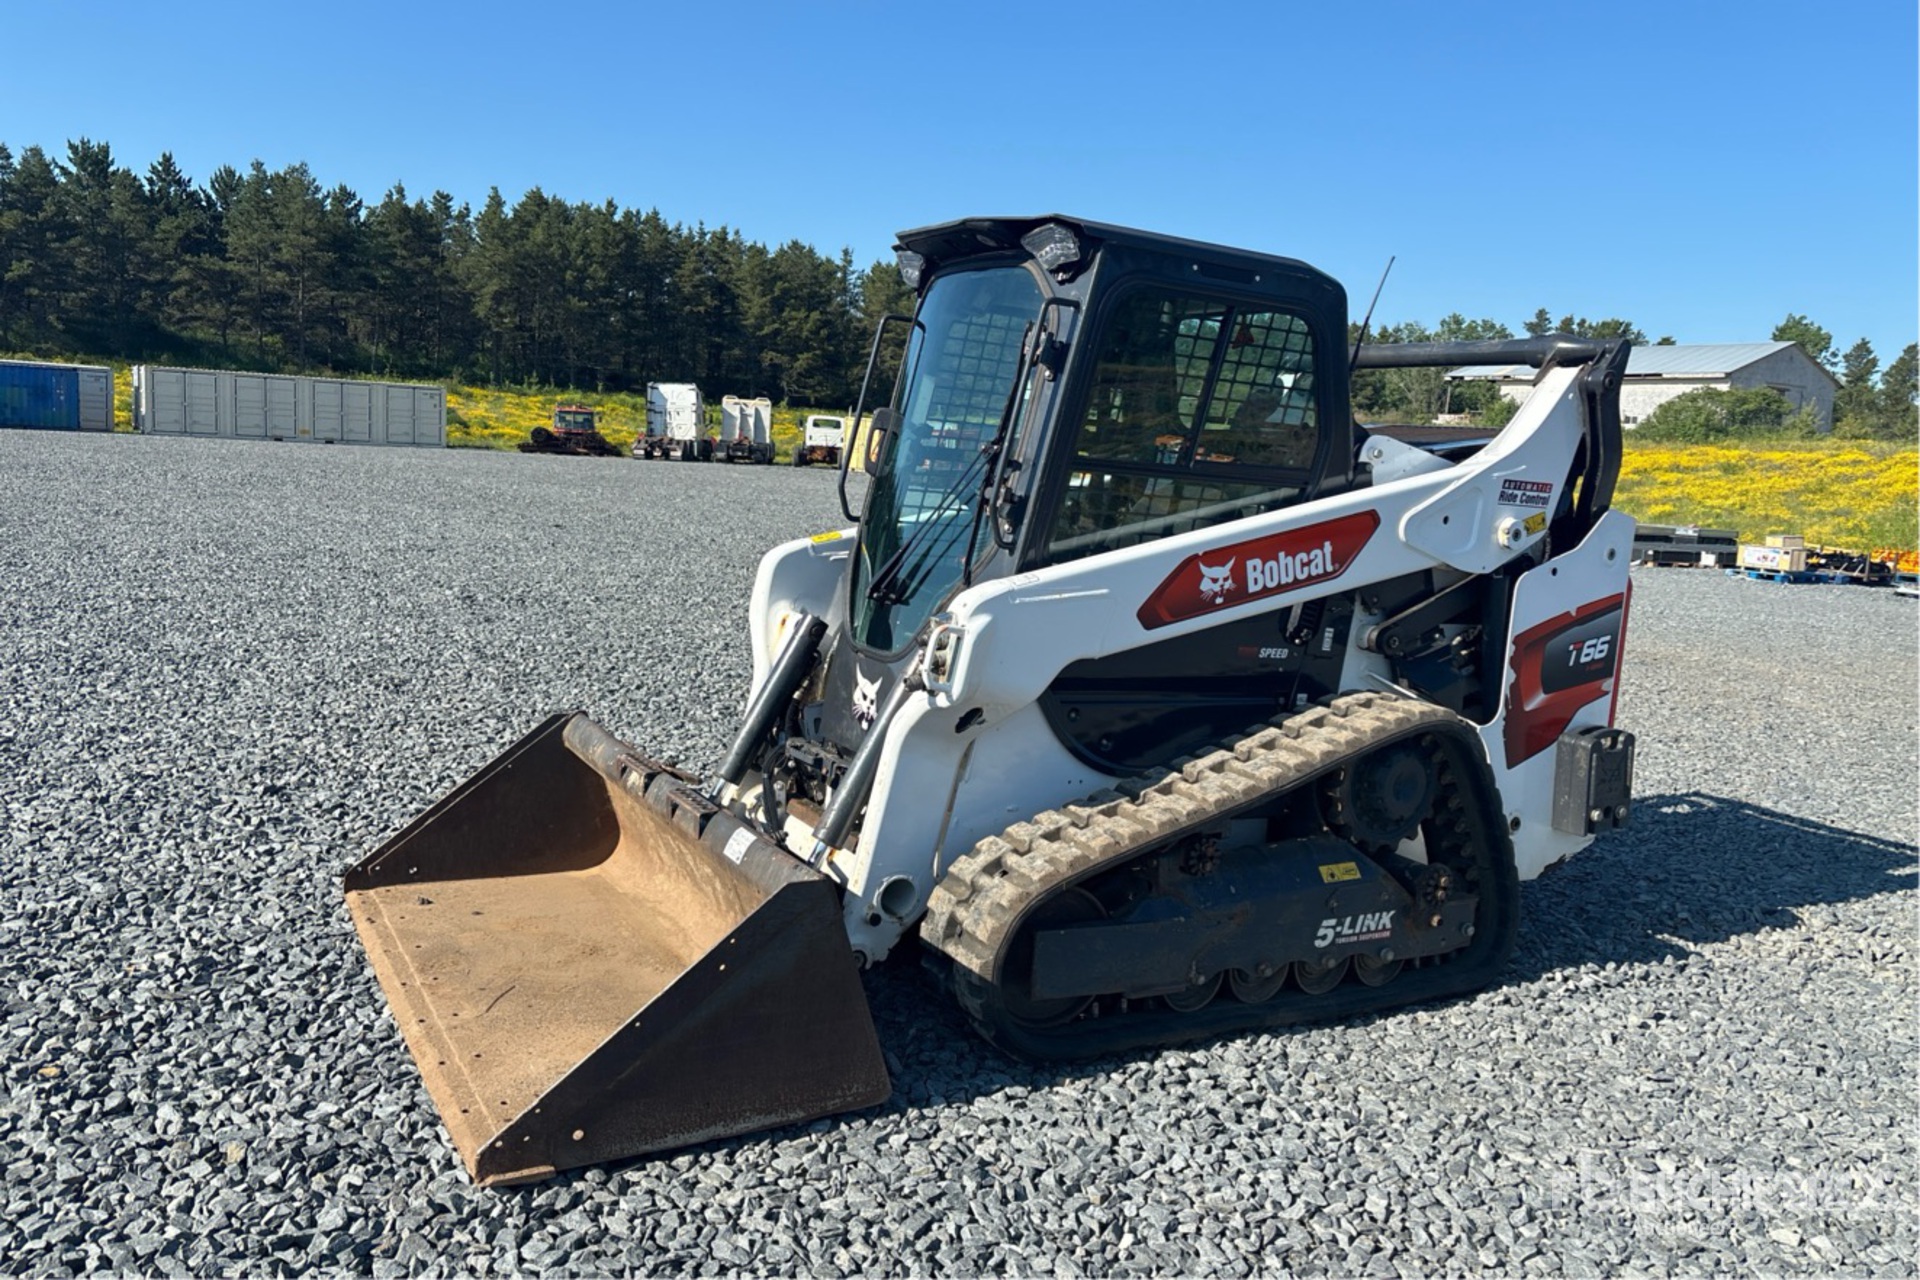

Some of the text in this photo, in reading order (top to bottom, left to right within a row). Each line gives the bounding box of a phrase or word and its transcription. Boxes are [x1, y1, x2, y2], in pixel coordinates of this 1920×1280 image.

[1499, 490, 1550, 506] Ride Control
[1504, 481, 1551, 493] AUTOMATIC
[1246, 541, 1334, 593] Bobcat
[1259, 648, 1289, 659] SPEED
[1568, 635, 1611, 667] T66
[1314, 910, 1396, 948] 5-LINK
